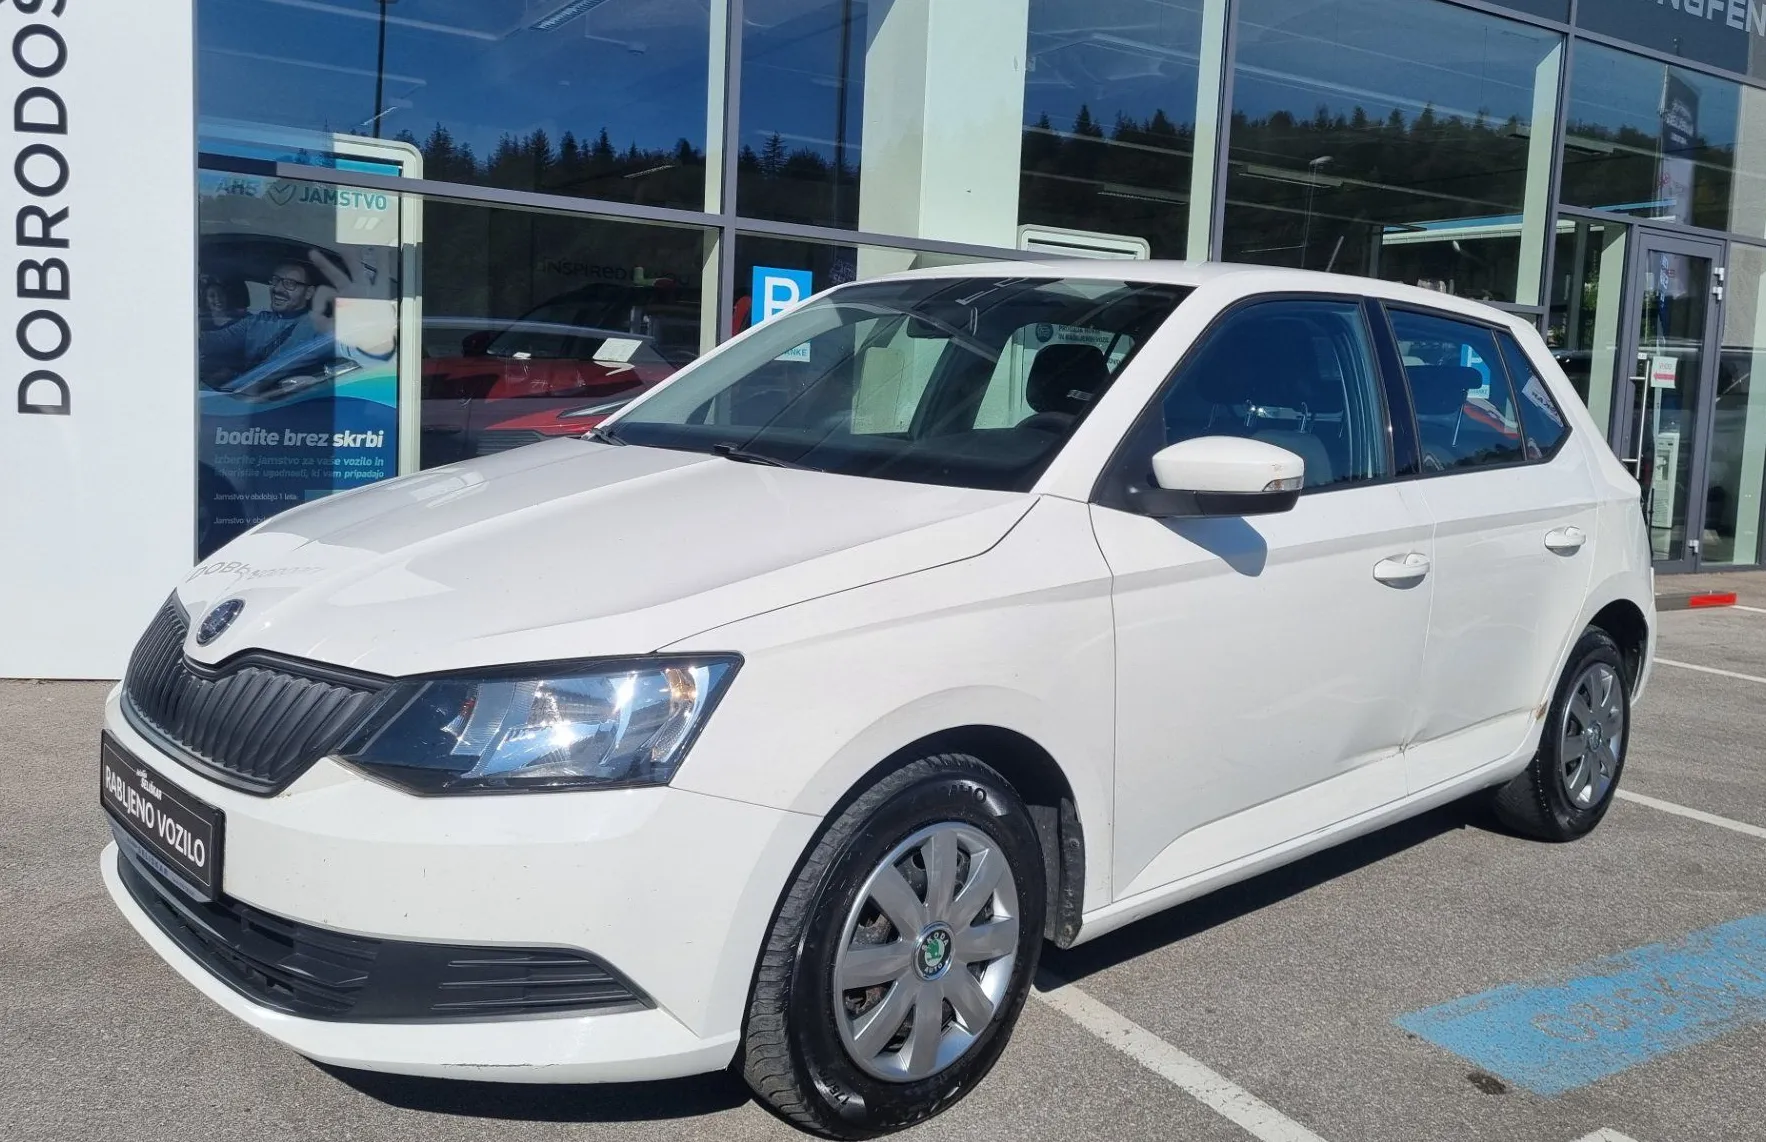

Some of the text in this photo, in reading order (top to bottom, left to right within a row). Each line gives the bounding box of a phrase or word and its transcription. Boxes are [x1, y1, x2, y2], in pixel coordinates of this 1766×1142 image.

[300, 186, 388, 211] JAMSTVO
[763, 276, 800, 321] P
[784, 347, 808, 357] ANKE
[214, 427, 385, 448] bodite brez skrbi
[256, 455, 300, 467] jamstvo
[343, 456, 373, 466] vozilo
[374, 456, 385, 466] in
[344, 469, 385, 480] pripadajo
[214, 493, 244, 501] Jamstvo
[214, 516, 245, 525] Jamstvo
[105, 765, 206, 868] RABLJENO VOZILO
